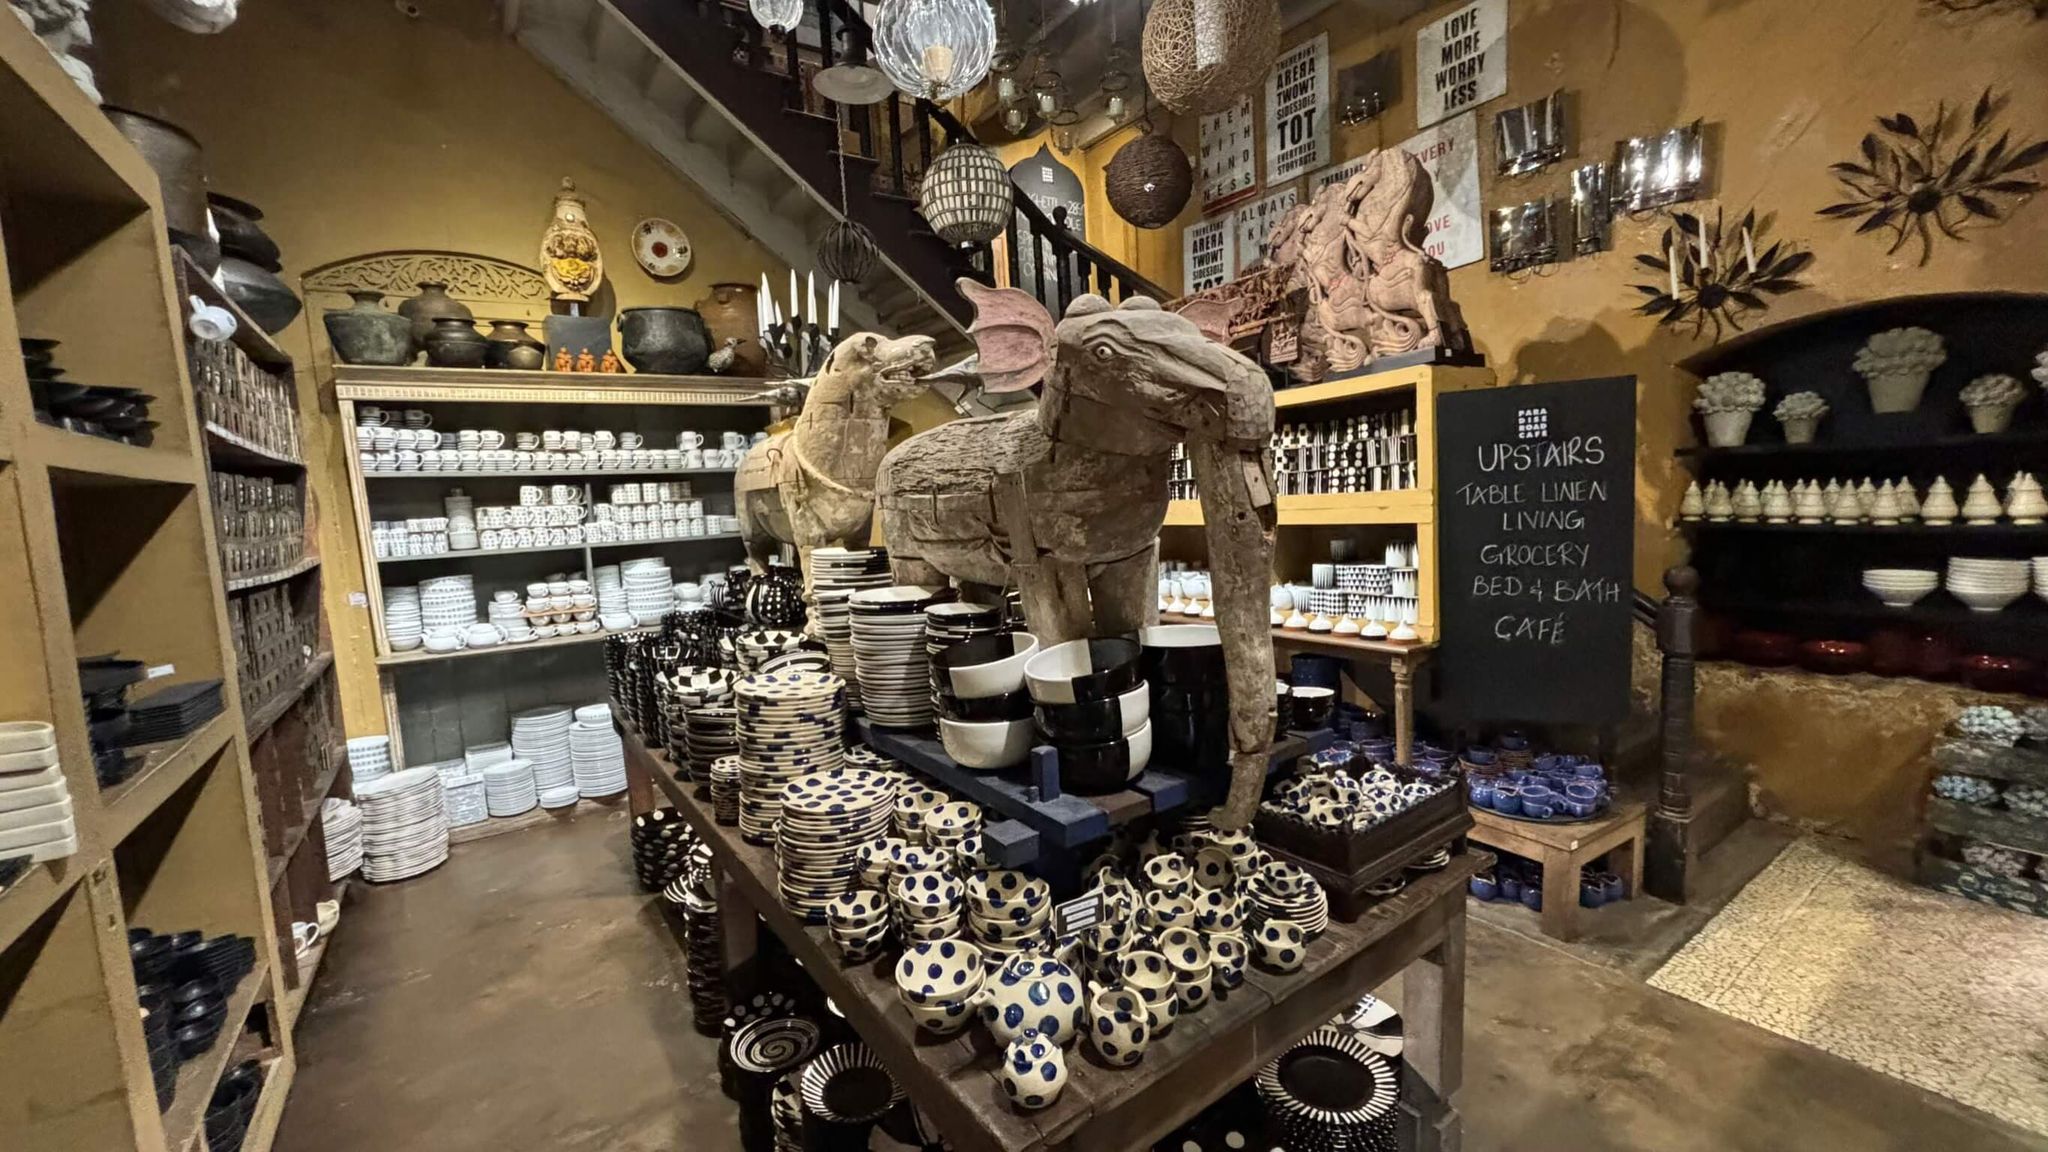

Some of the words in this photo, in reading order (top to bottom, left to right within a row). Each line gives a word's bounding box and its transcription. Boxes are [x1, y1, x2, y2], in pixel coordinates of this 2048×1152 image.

[1444, 8, 1478, 42] LOVE
[1441, 30, 1480, 66] MORE
[1435, 52, 1485, 92] WORRY
[1444, 80, 1477, 111] LESS
[1202, 125, 1250, 159] WITH
[1277, 107, 1316, 150] TOT
[1203, 172, 1251, 202] NESS
[1240, 192, 1296, 223] ALWAYS
[1427, 214, 1451, 234] OVE
[1518, 408, 1547, 417] PARA
[1518, 415, 1547, 424] DISE
[1518, 423, 1548, 432] ROAD
[1518, 430, 1548, 439] CAFE
[1478, 435, 1606, 472] UPSTAIRS
[1456, 482, 1527, 506] TABLE
[1541, 480, 1607, 503] LINEN
[1502, 509, 1585, 531] LIVING
[1480, 541, 1590, 569] GROCERY
[1472, 575, 1523, 597] BED
[1553, 577, 1621, 604] BATH
[1494, 611, 1567, 645] CAFÉ
